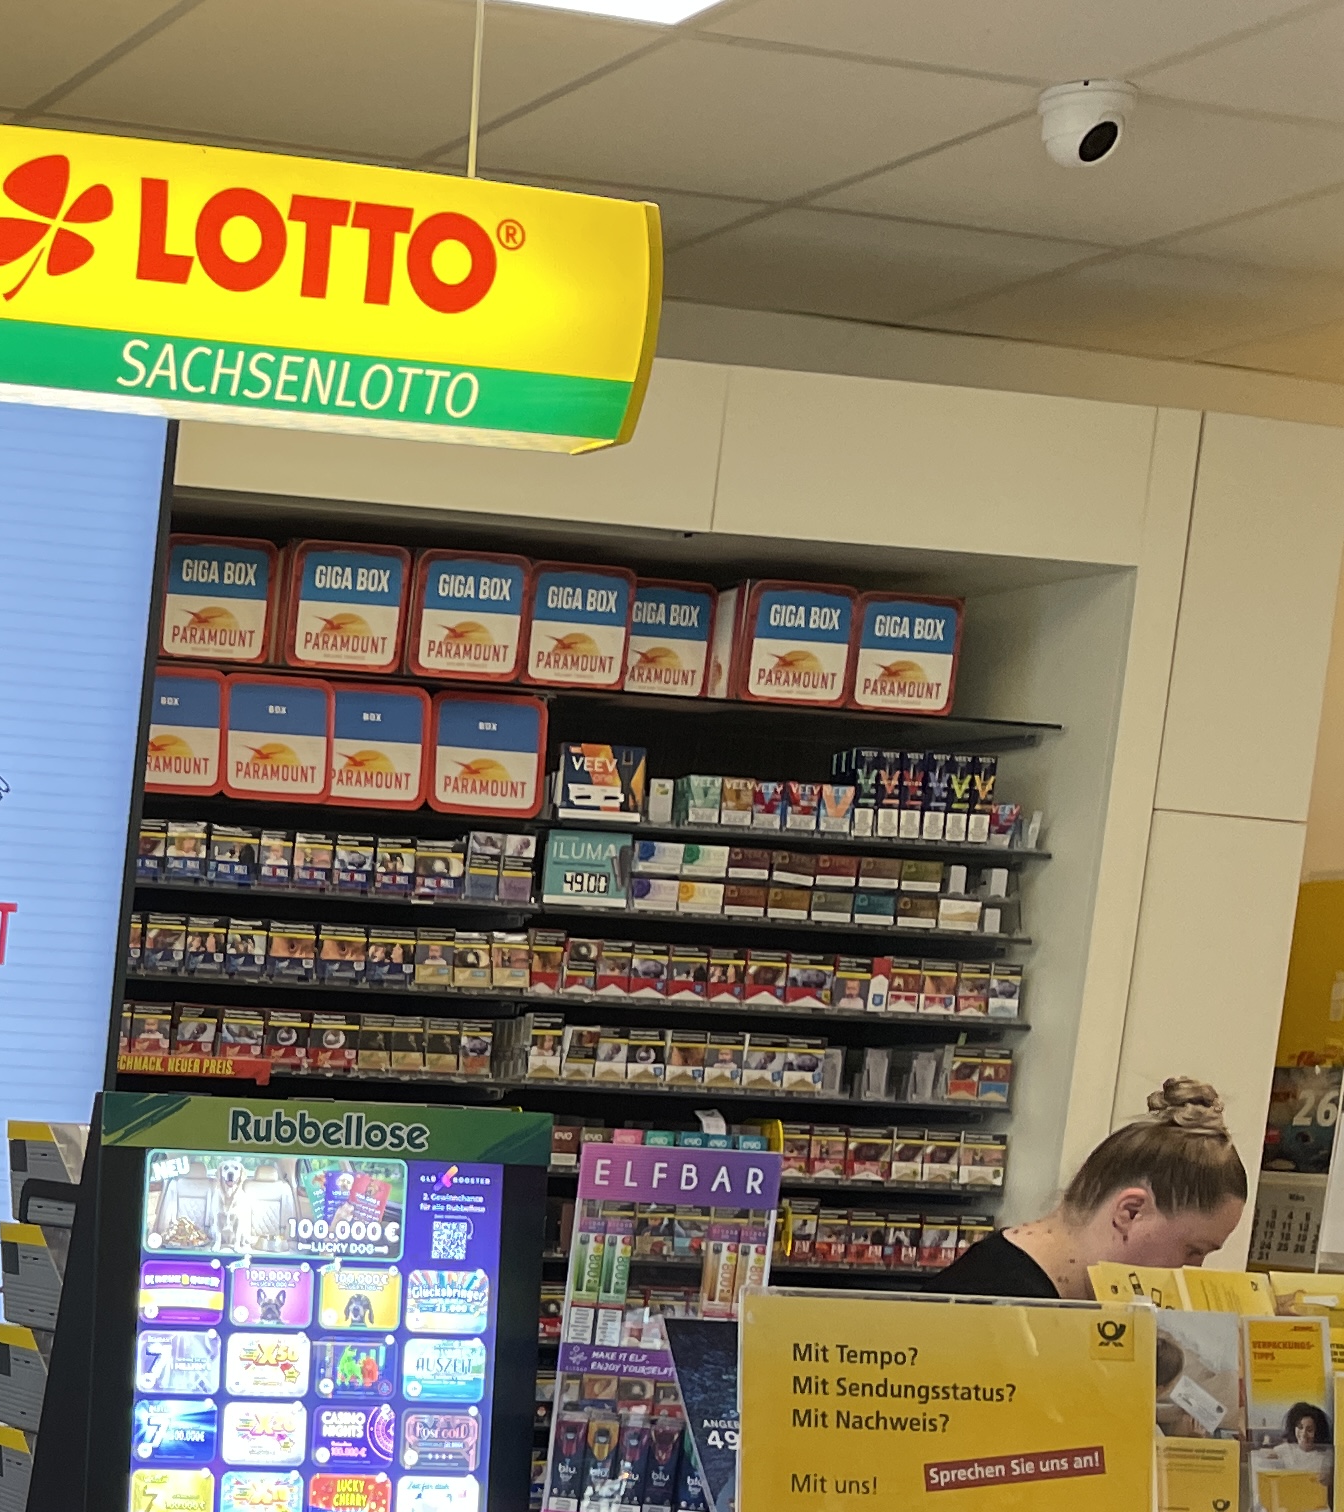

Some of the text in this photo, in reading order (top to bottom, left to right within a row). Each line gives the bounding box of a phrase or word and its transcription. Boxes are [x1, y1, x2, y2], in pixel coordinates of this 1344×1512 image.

[136, 177, 497, 314] LOTTO
[116, 338, 479, 419] SACHSENLOTTO
[182, 559, 256, 586] GIGA BOX
[315, 565, 390, 593] GIGA BOX
[438, 573, 512, 601] GIGA BOX
[547, 585, 618, 614] GIGA BOX
[770, 603, 841, 631] GIGA BOX
[172, 625, 256, 648] PARAMOUNT
[572, 756, 618, 772] VEEV
[553, 842, 617, 861] ILUMA
[564, 873, 608, 893] 49.00
[168, 1059, 200, 1074] NEUER
[203, 1059, 235, 1076] PREIS.
[229, 1107, 430, 1152] Rubbellose
[153, 1157, 190, 1178] NEU
[594, 1158, 764, 1194] ELFBAR
[792, 1342, 918, 1368] Mit Tempo?
[792, 1376, 1017, 1404] Mit Sendungsstatus?
[321, 1411, 366, 1427] CASINO
[322, 1424, 364, 1438] NIGHTS
[791, 1408, 951, 1435] Mit Nachweis?
[929, 1451, 1100, 1487] Sprechen Sie uns an!
[336, 1478, 365, 1494] LUCKY
[790, 1473, 877, 1496] Mit uns!
[333, 1492, 367, 1508] CHERRY
